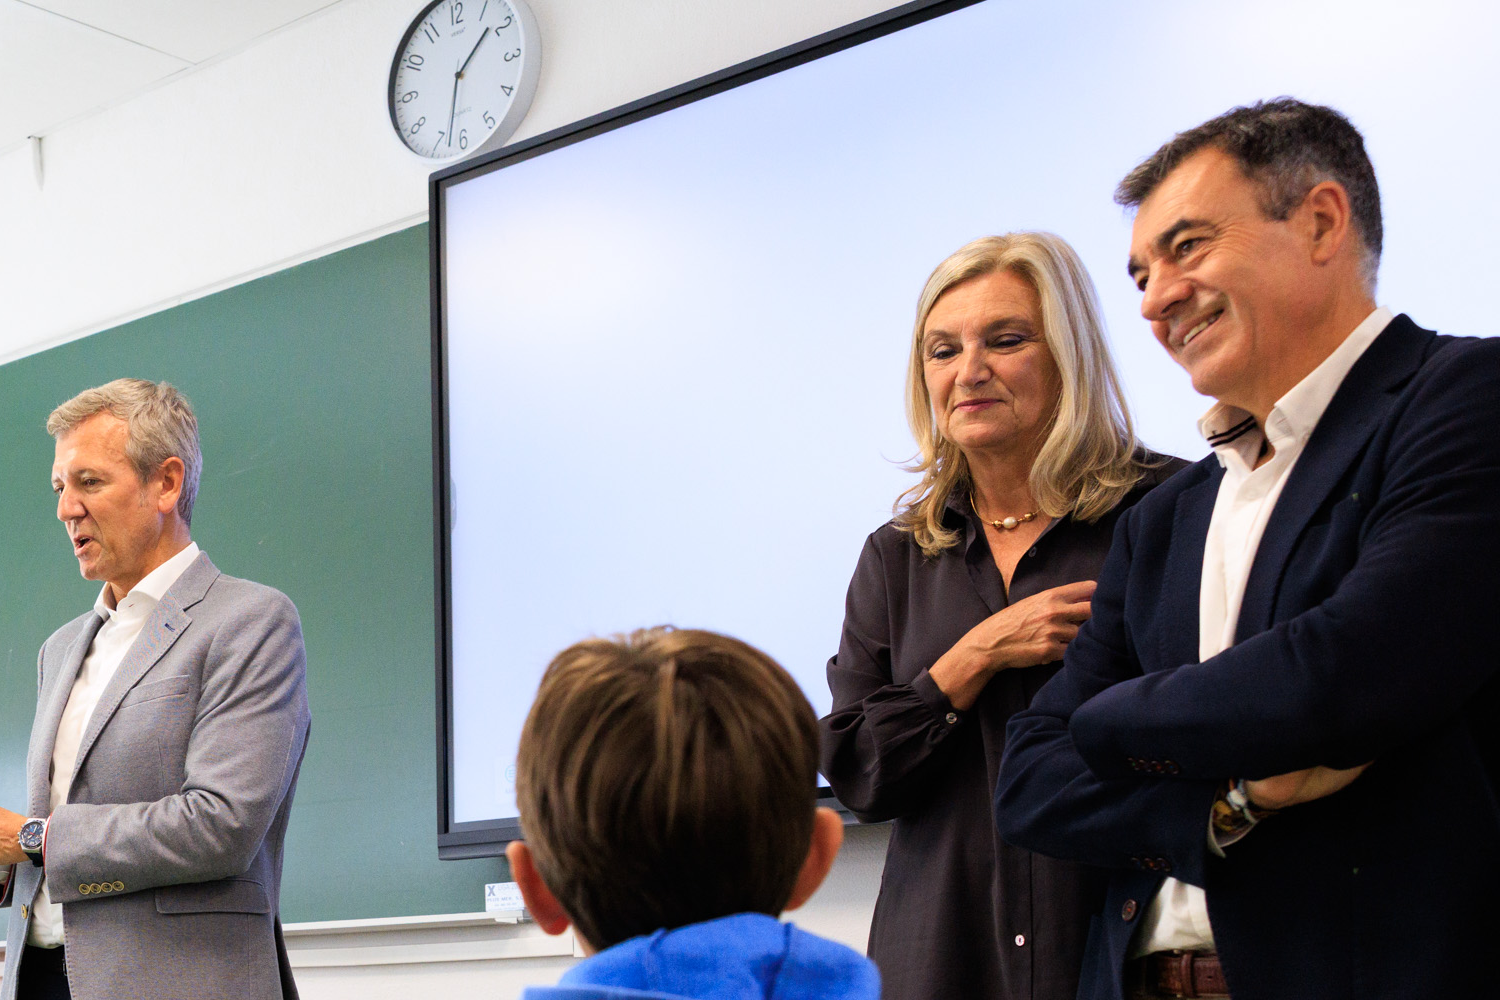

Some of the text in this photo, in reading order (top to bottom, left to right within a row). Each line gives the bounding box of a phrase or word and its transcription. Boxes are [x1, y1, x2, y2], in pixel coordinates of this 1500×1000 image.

[450, 2, 464, 26] 12
[479, 0, 488, 22] 1
[424, 22, 440, 44] 11
[494, 15, 512, 37] 2
[406, 54, 425, 72] 10
[503, 48, 521, 63] 3
[401, 90, 419, 104] 9
[500, 84, 514, 97] 4
[410, 116, 426, 135] 8
[482, 110, 496, 130] 5
[433, 130, 445, 151] 7
[458, 128, 468, 150] 6
